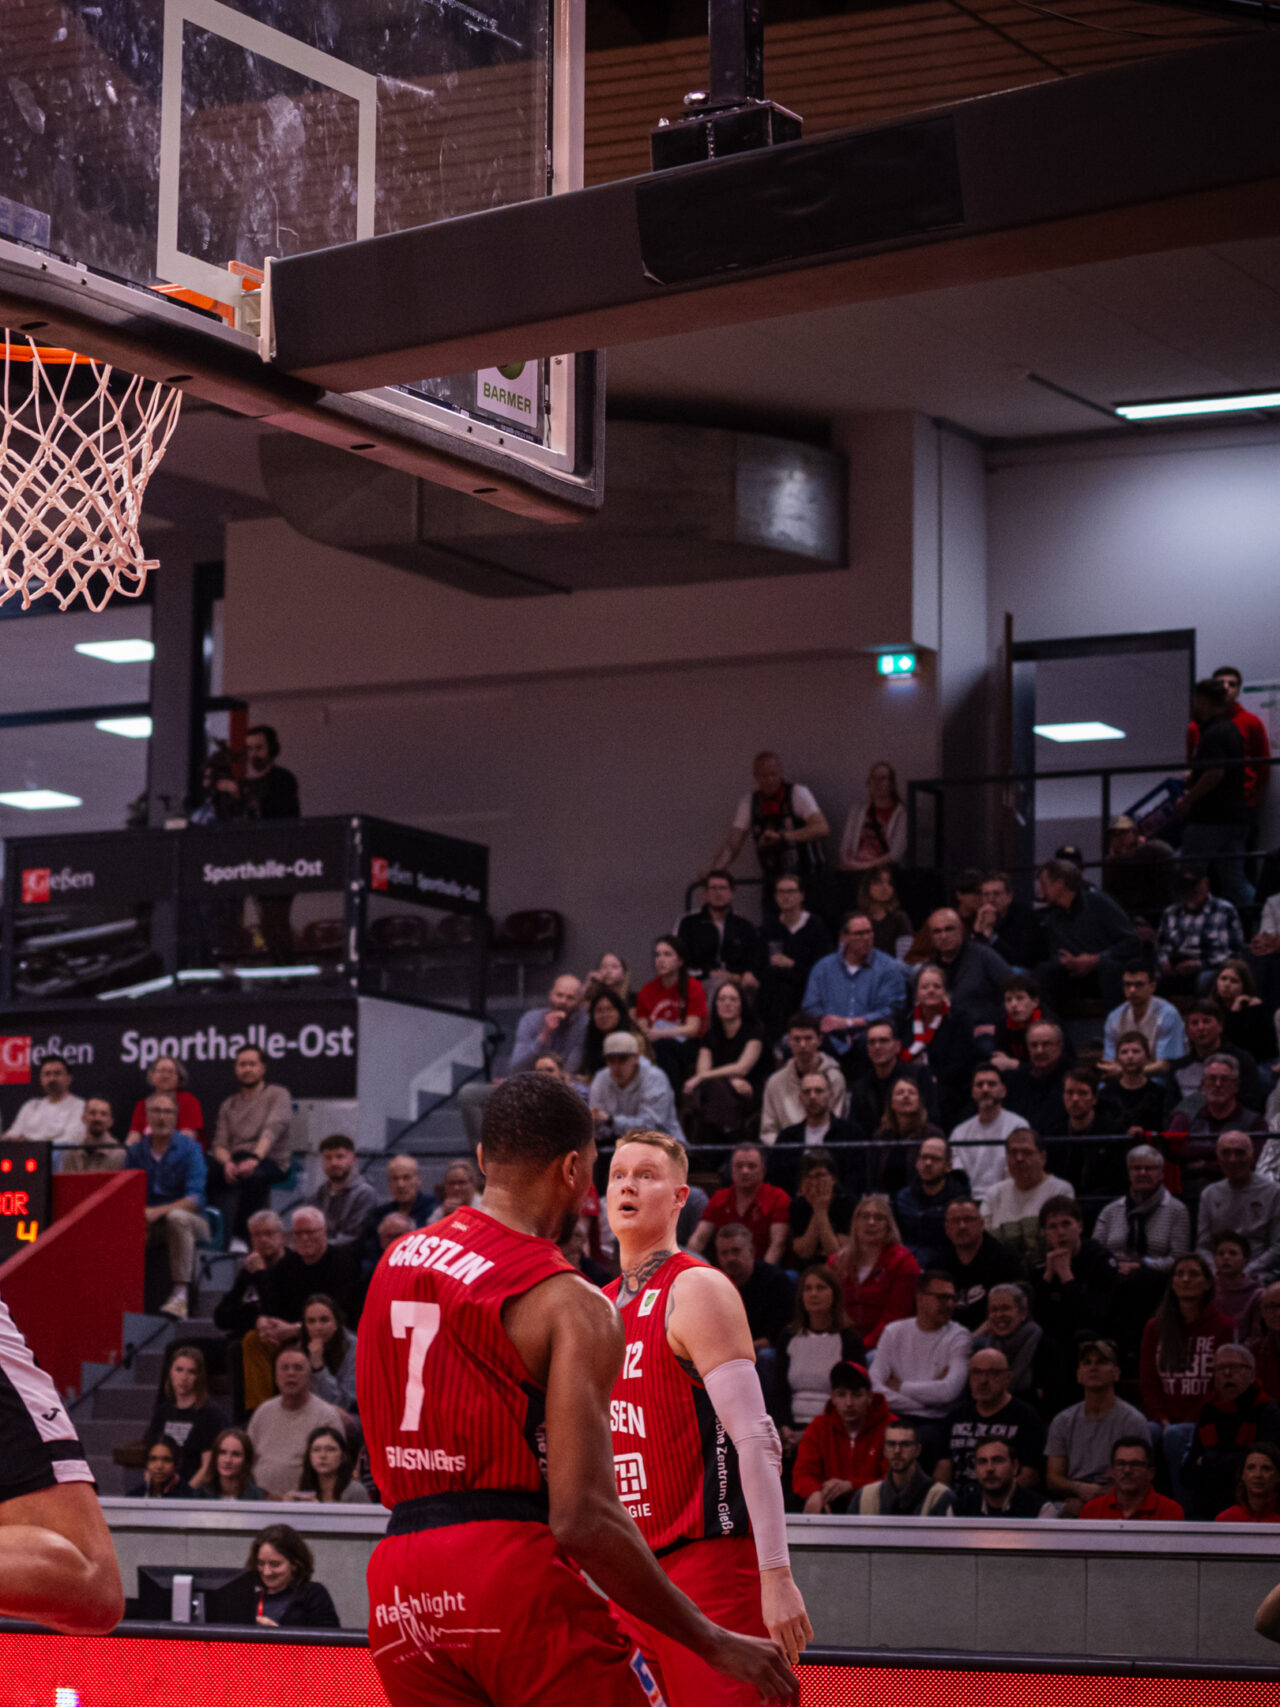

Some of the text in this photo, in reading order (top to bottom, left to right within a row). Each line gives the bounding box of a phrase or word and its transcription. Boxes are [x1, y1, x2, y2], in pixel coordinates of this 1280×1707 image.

[483, 381, 532, 414] BARMER
[203, 858, 323, 885] Sporthalle-Ost
[2, 1024, 355, 1071] Gießen Sporthalle-Ost
[390, 1300, 442, 1432] 7
[622, 1340, 644, 1380] 12
[375, 1589, 467, 1628] flashlight
